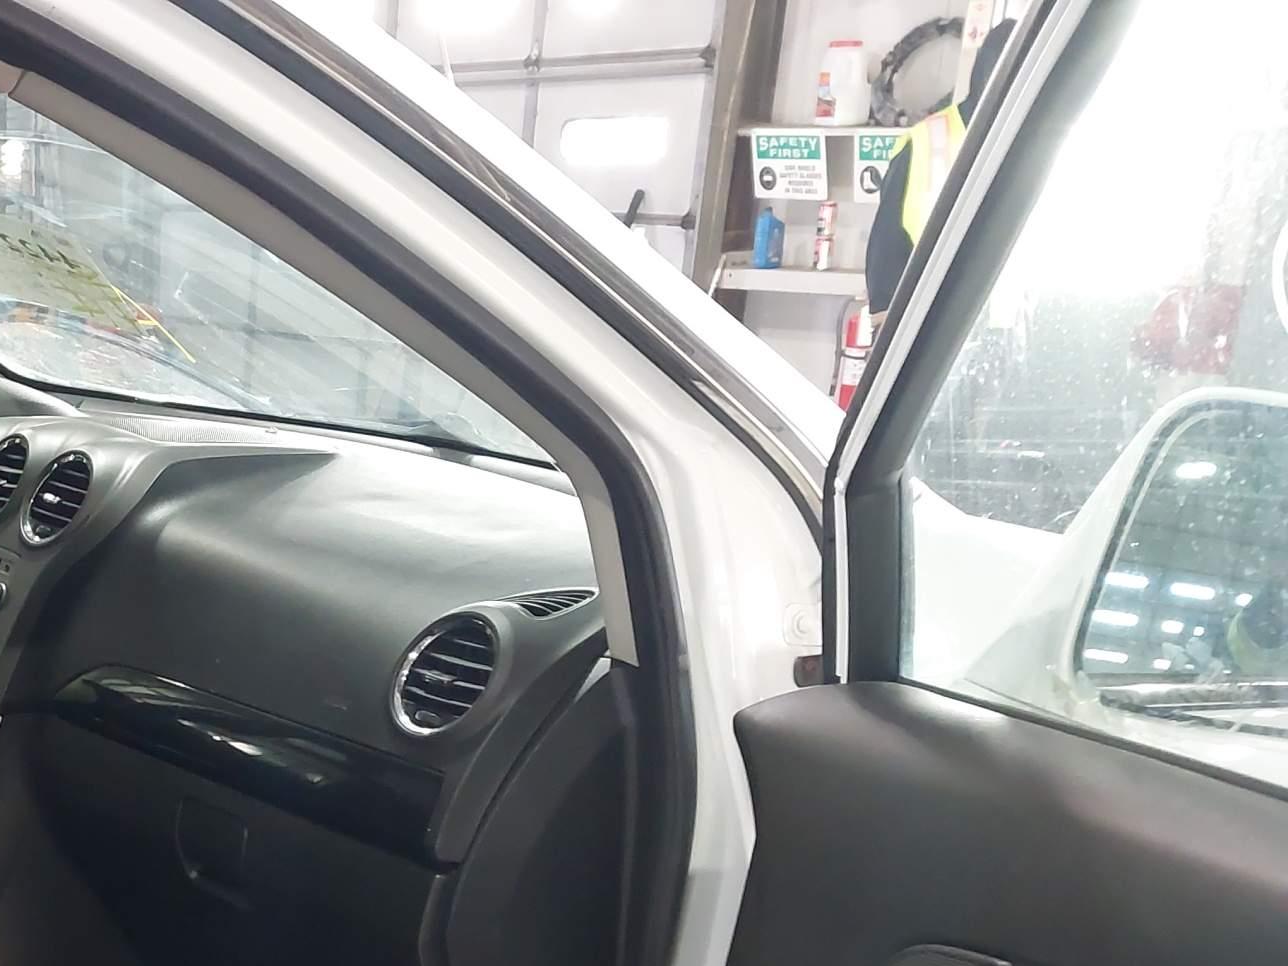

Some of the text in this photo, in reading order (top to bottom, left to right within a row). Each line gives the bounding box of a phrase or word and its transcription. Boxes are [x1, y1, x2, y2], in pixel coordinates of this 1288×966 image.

[759, 136, 817, 151] SAFETY
[862, 137, 894, 153] SAF
[769, 148, 809, 158] FIRST
